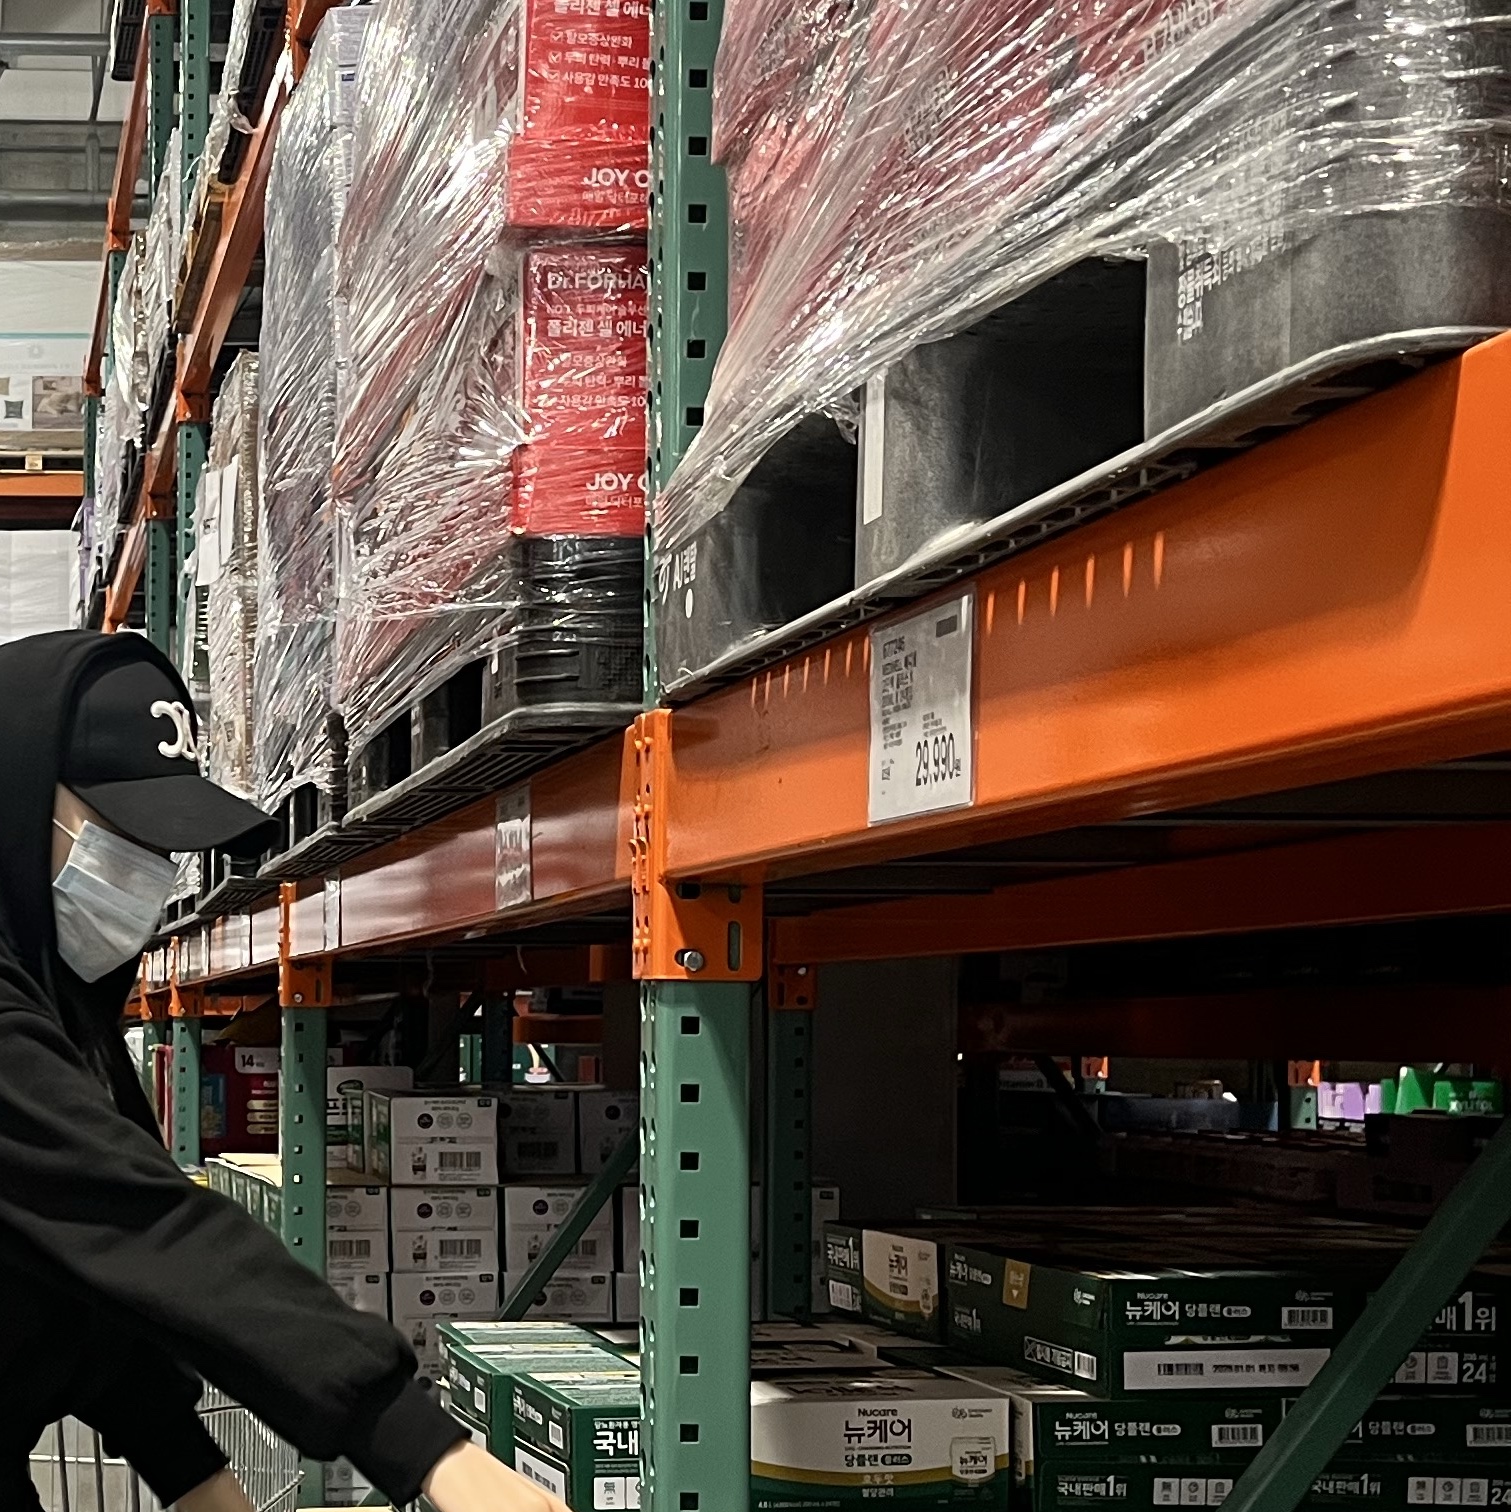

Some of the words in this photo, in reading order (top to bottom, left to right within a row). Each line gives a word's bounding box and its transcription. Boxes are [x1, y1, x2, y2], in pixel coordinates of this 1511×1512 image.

[583, 168, 630, 186] JOY
[586, 472, 633, 491] JOY
[916, 733, 955, 789] 29,990
[1125, 1301, 1180, 1321] 뉴케어
[1462, 1362, 1486, 1383] 24
[858, 1408, 898, 1417] Nucare
[843, 1418, 912, 1444] 뉴케어
[1054, 1420, 1109, 1440] 뉴케어
